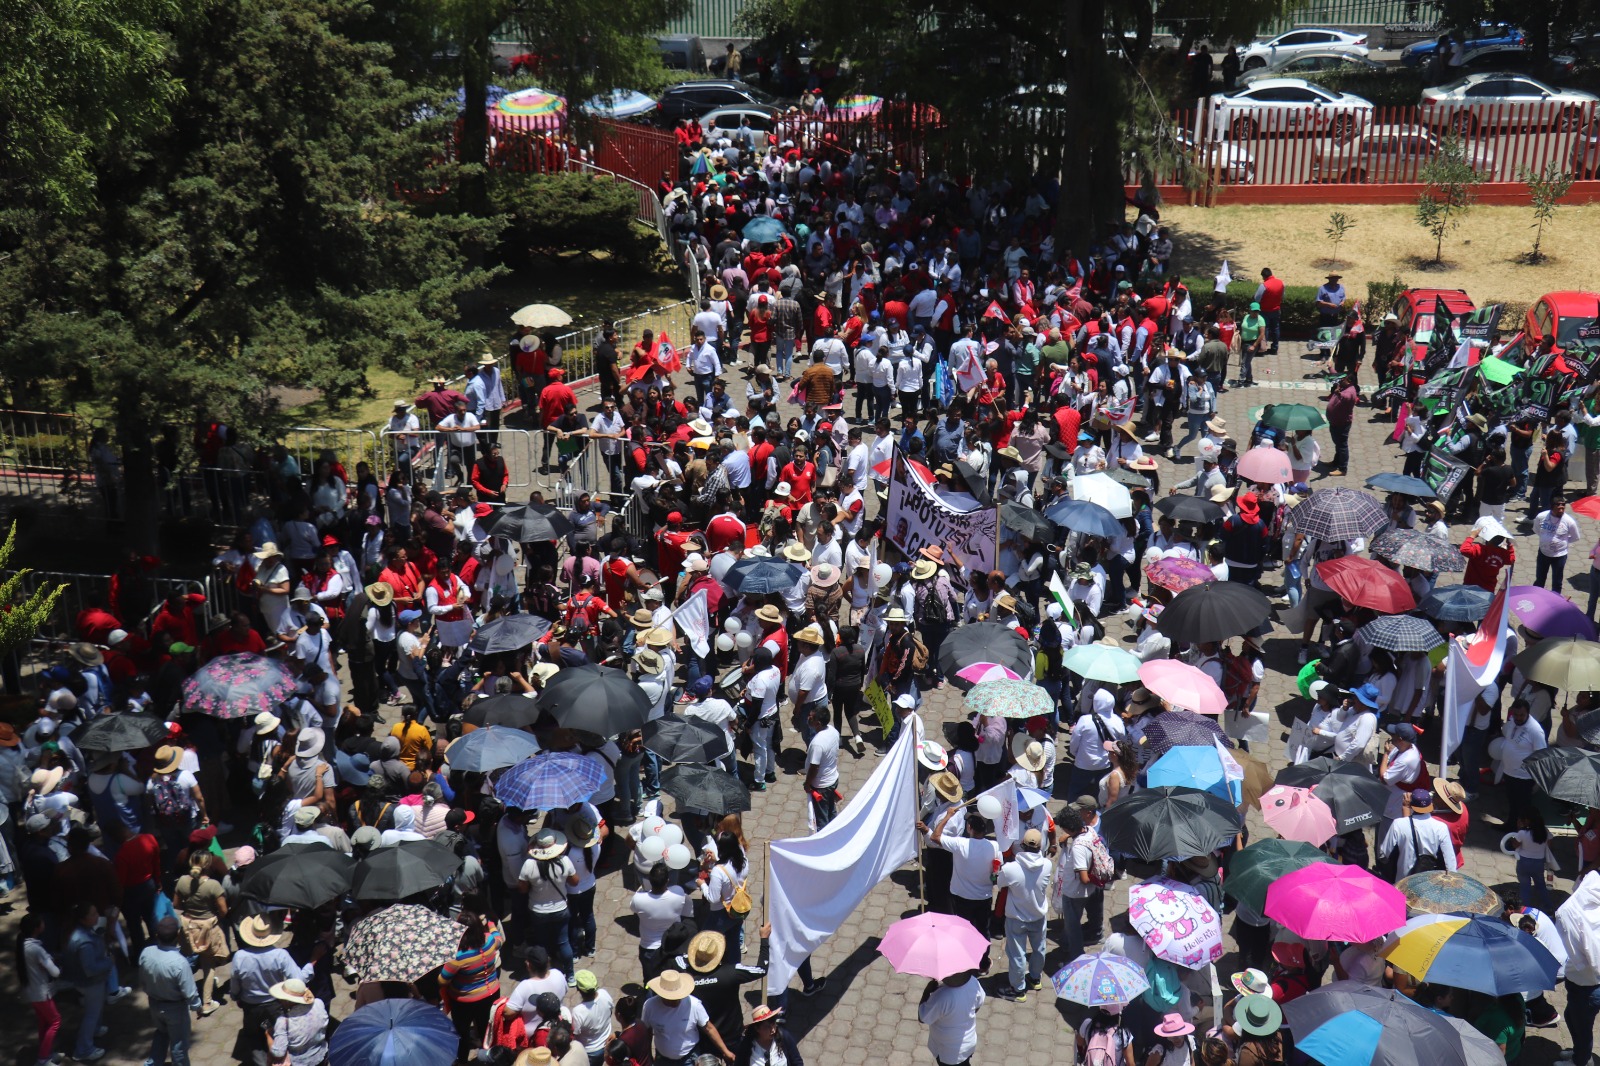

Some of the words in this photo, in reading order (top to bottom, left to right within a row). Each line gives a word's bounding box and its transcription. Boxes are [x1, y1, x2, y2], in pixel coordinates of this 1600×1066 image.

[1183, 936, 1204, 952] Hello
[1203, 928, 1218, 942] Kitty
[1418, 935, 1446, 972] NAUTICA
[694, 977, 718, 986] adidas
